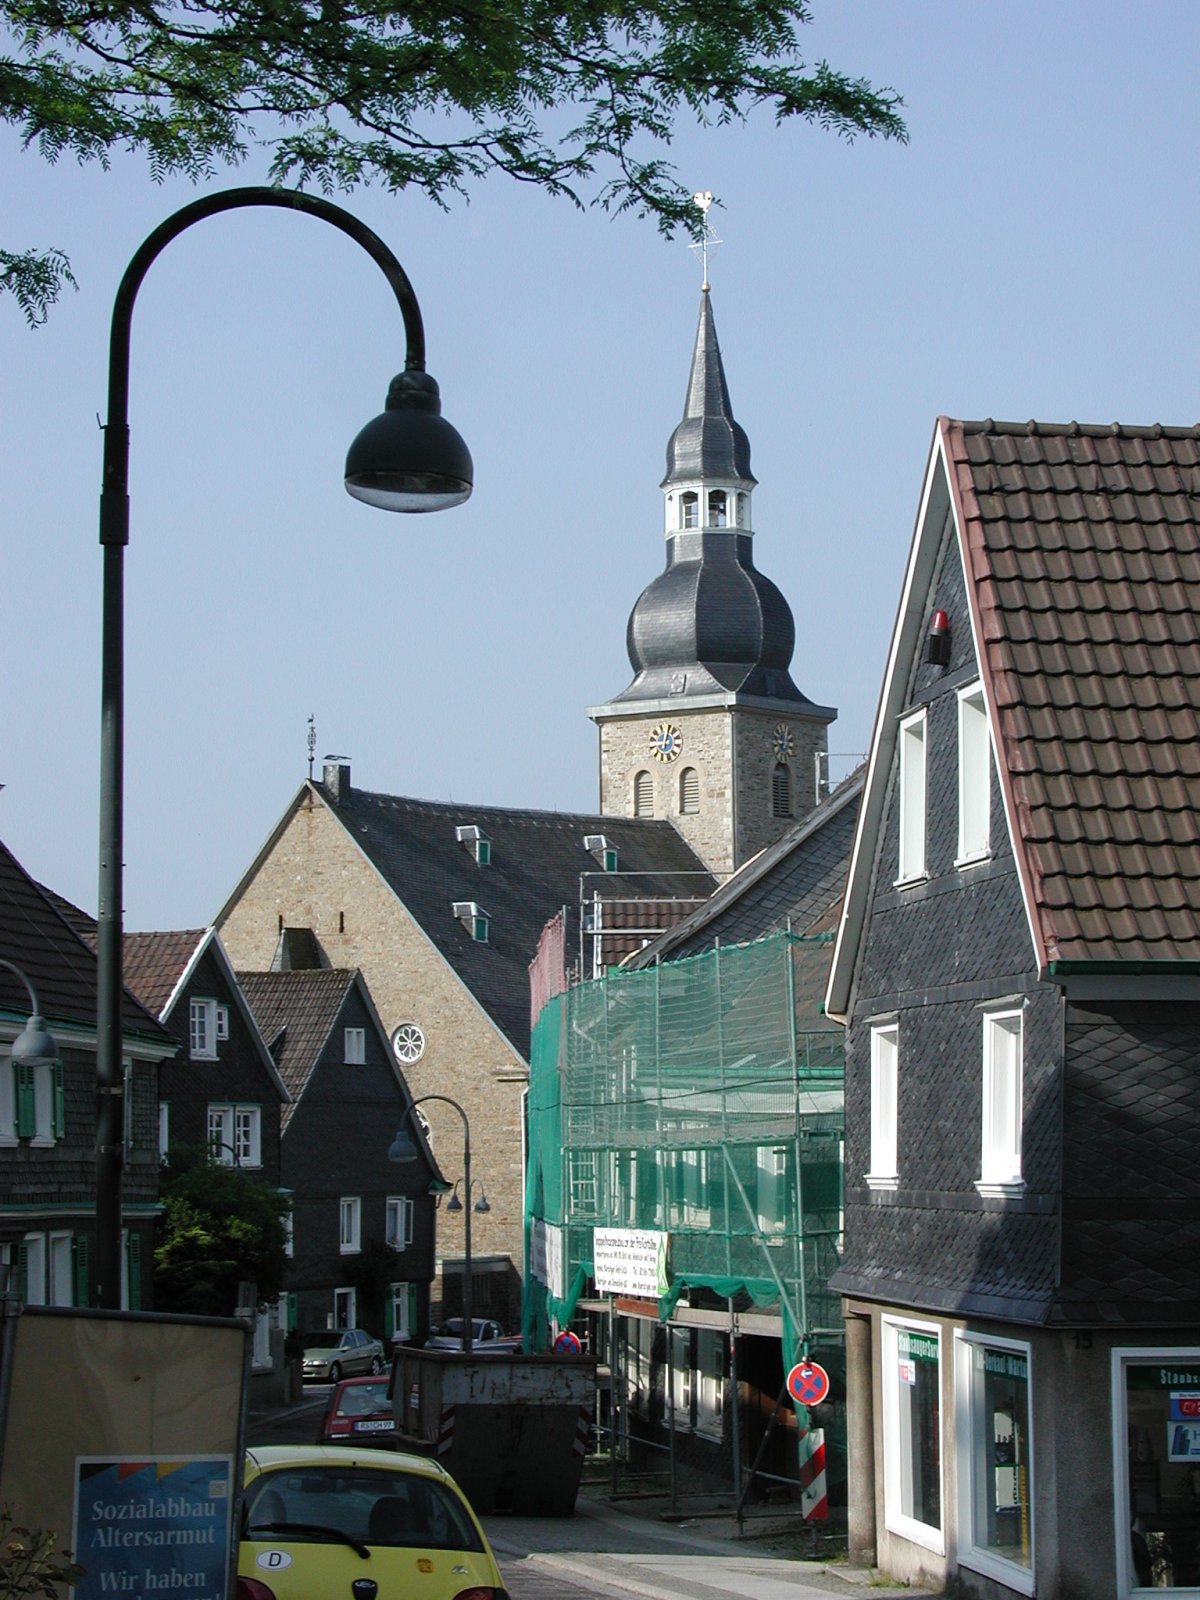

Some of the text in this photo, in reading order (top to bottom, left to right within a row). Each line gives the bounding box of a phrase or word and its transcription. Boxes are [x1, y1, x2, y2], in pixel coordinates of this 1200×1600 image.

[1072, 1335, 1093, 1350] 15
[1160, 1368, 1200, 1385] Staubs
[92, 1497, 216, 1521] Sozialabbau
[90, 1525, 215, 1548] Altersarmut
[268, 1552, 282, 1567] D
[100, 1567, 206, 1592] Wir haben
